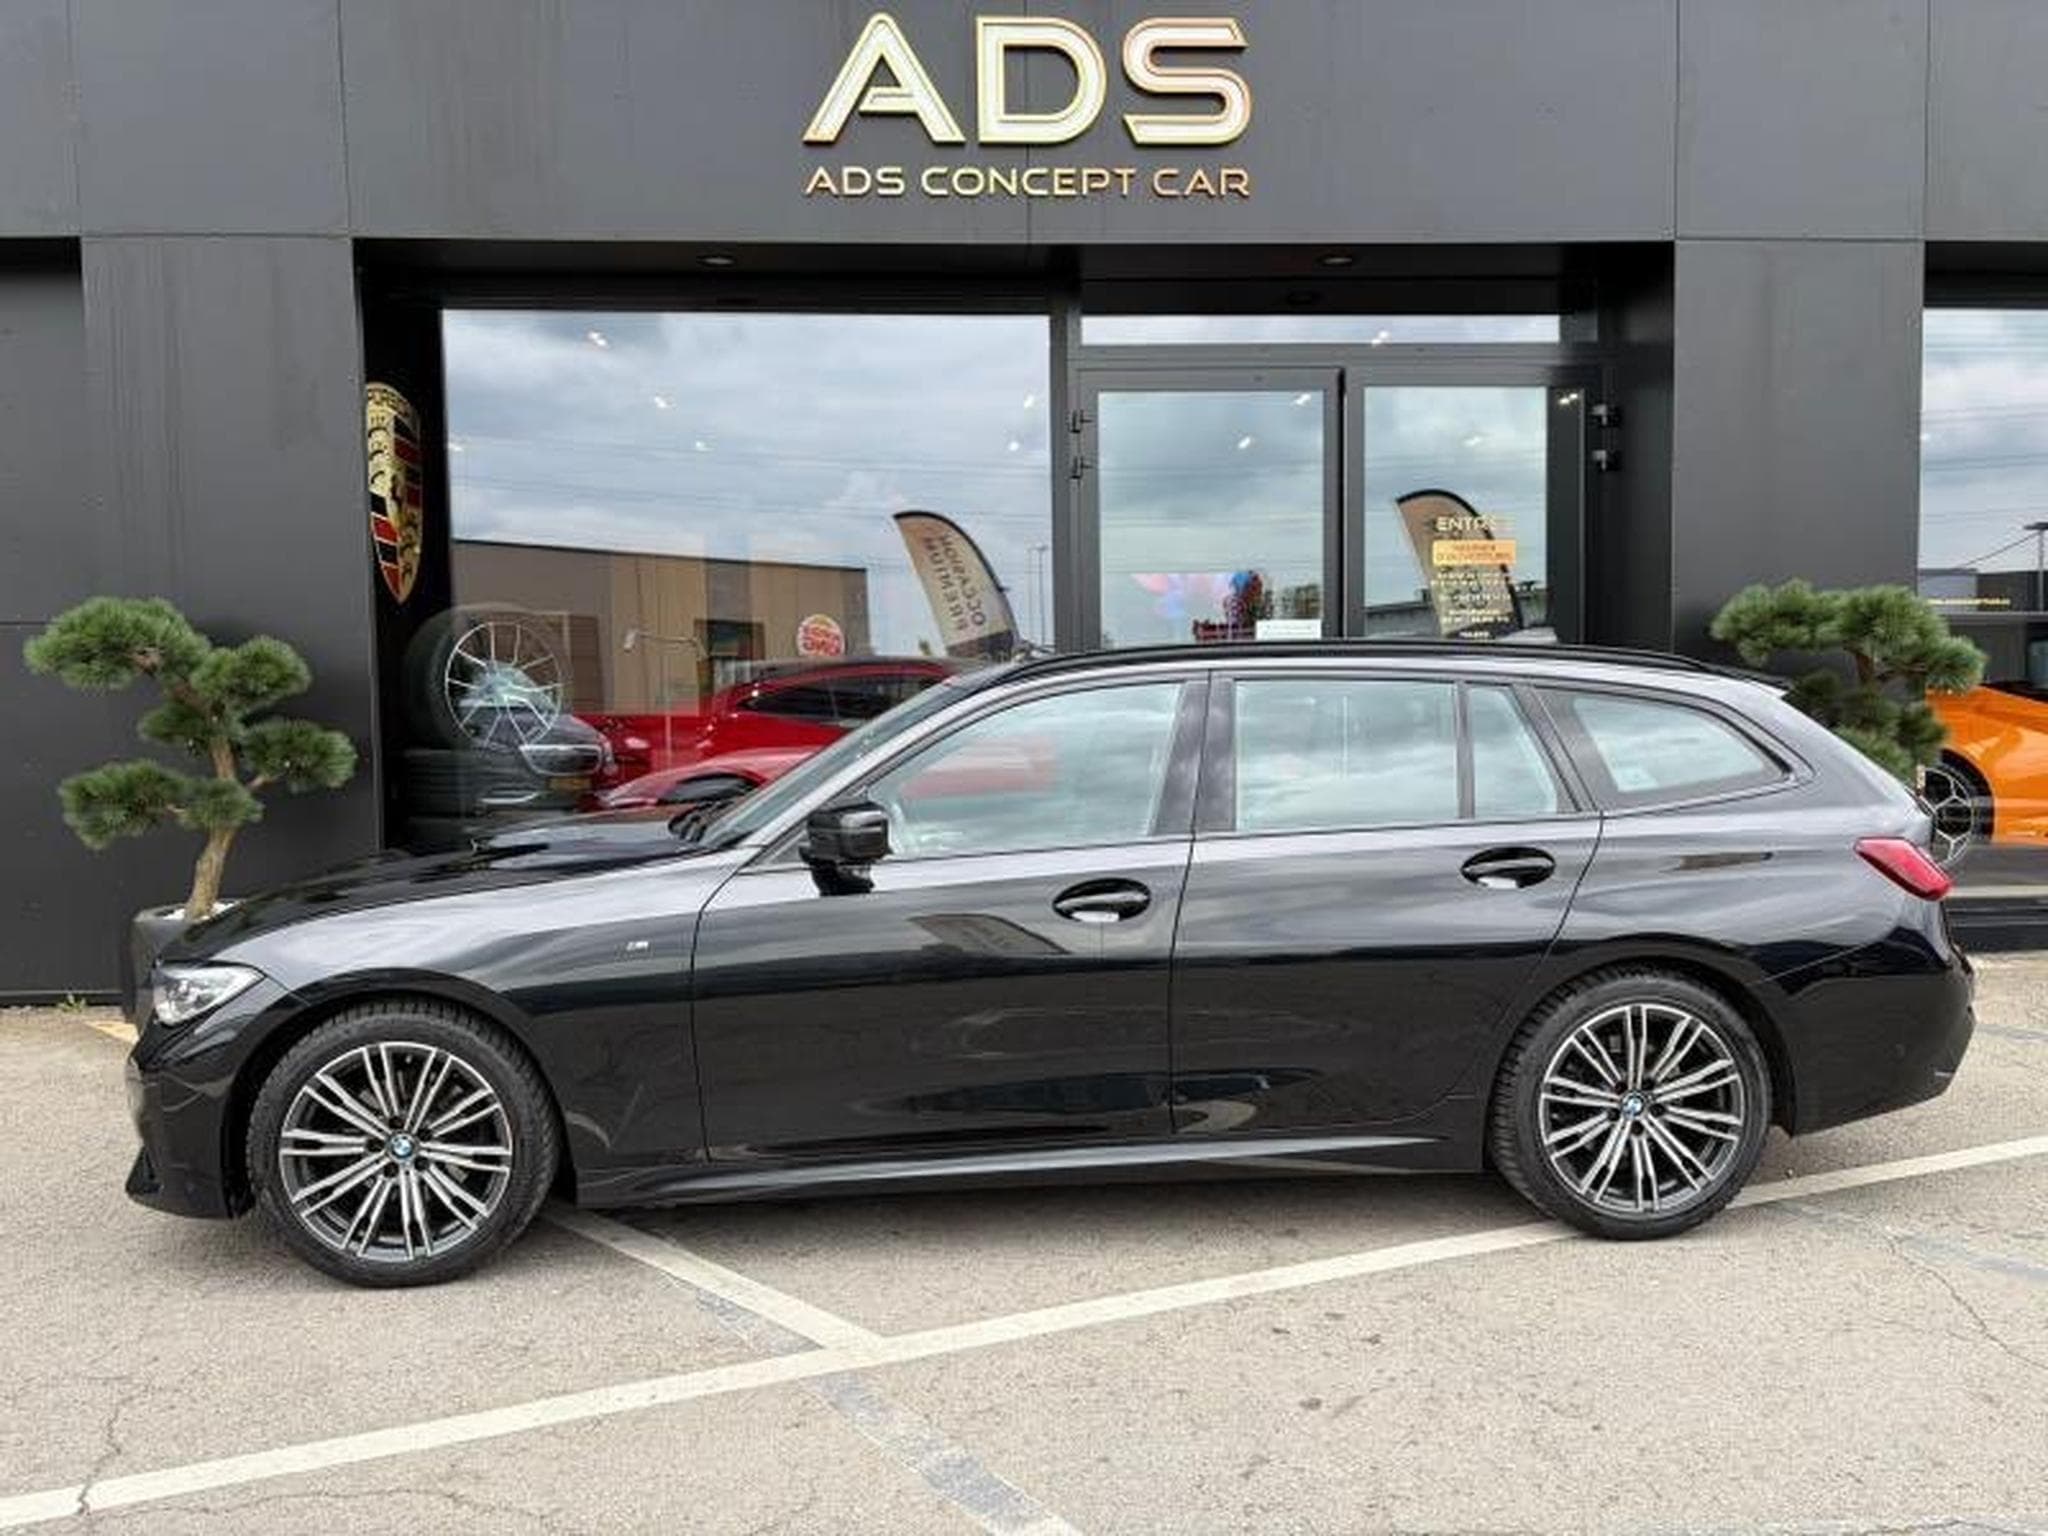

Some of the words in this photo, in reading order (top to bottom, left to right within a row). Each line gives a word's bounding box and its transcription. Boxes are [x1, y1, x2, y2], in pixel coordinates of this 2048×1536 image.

[802, 11, 1252, 145] ADS
[804, 166, 905, 197] ADS
[920, 166, 1138, 198] CONCEPT
[1153, 167, 1250, 198] CAR
